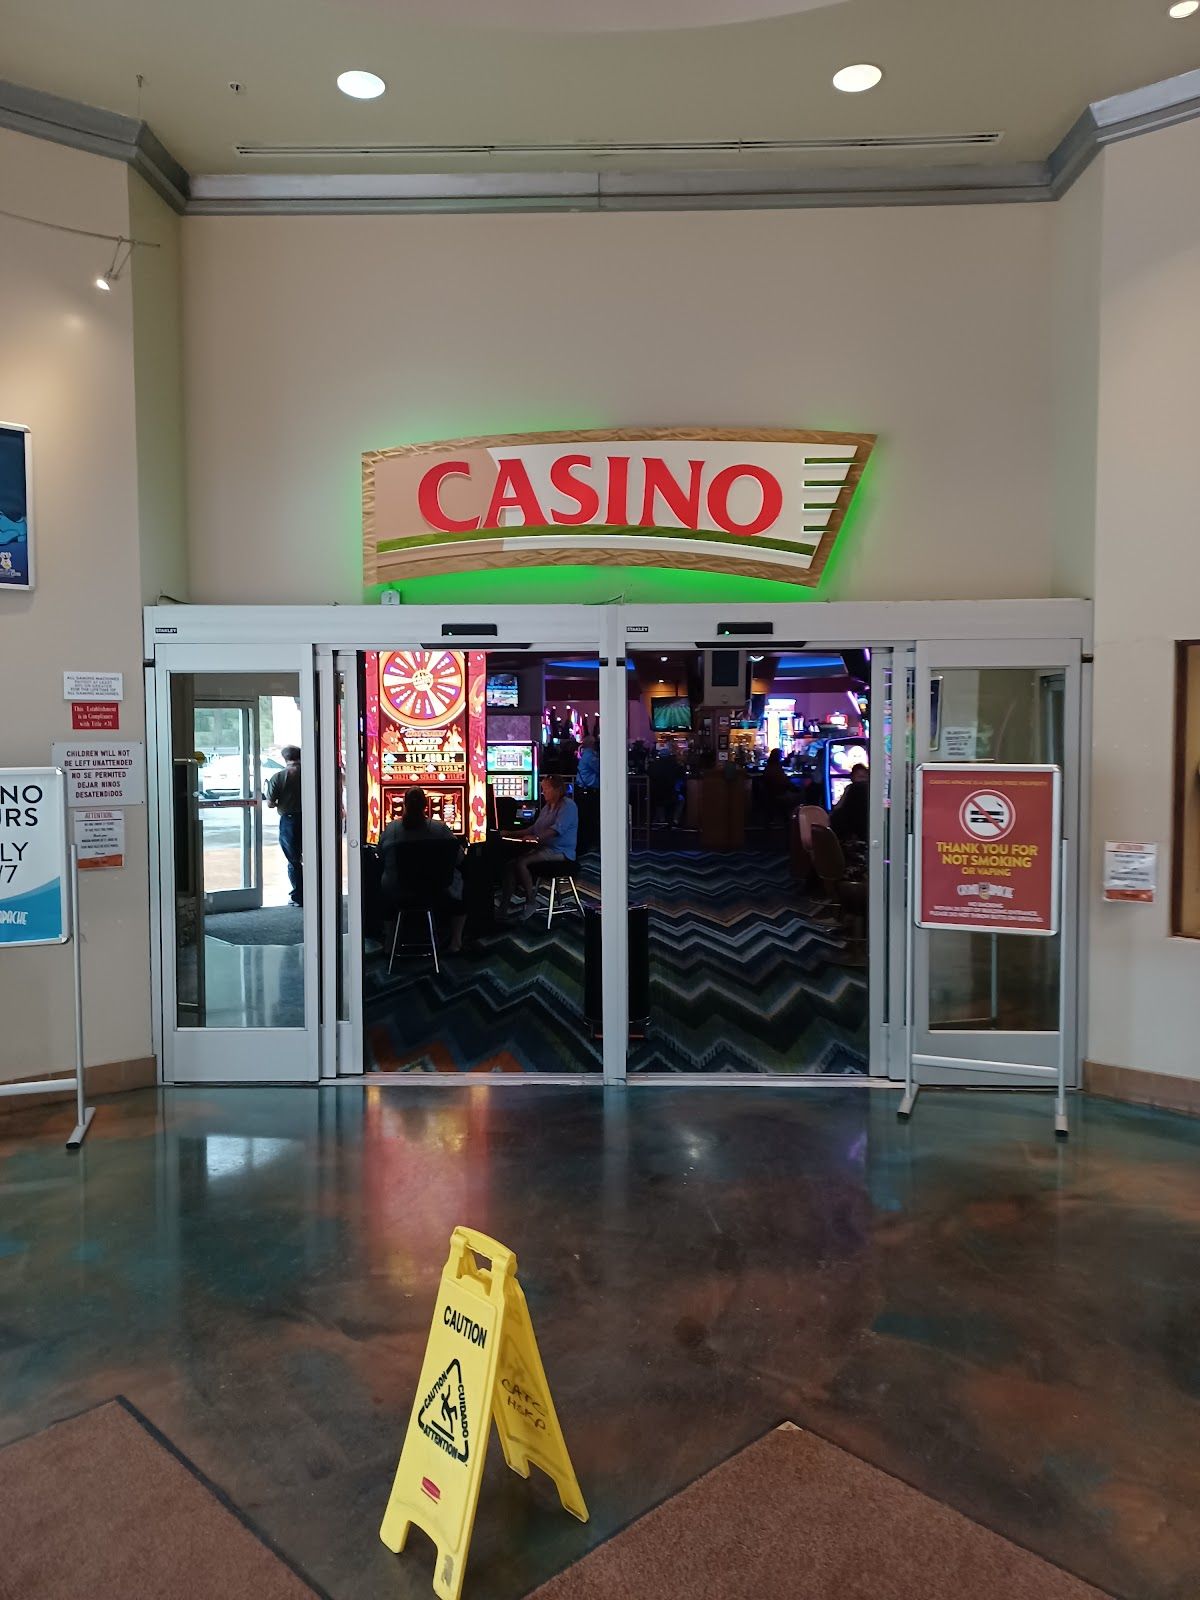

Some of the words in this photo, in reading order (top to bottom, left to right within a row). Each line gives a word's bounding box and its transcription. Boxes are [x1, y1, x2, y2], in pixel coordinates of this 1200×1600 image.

[417, 454, 783, 536] CASINO
[936, 842, 979, 853] THANK
[982, 843, 1008, 854] YOU
[1012, 844, 1038, 856] FOR
[942, 854, 968, 865] NOT
[971, 855, 1032, 868] SMOKING
[962, 866, 975, 875] OR
[977, 868, 1011, 877] VAPING
[443, 1305, 488, 1349] CAUTION
[424, 1370, 448, 1409] CAUTION
[458, 1384, 469, 1438] CUIDADO
[423, 1424, 459, 1459] ATTENTION
